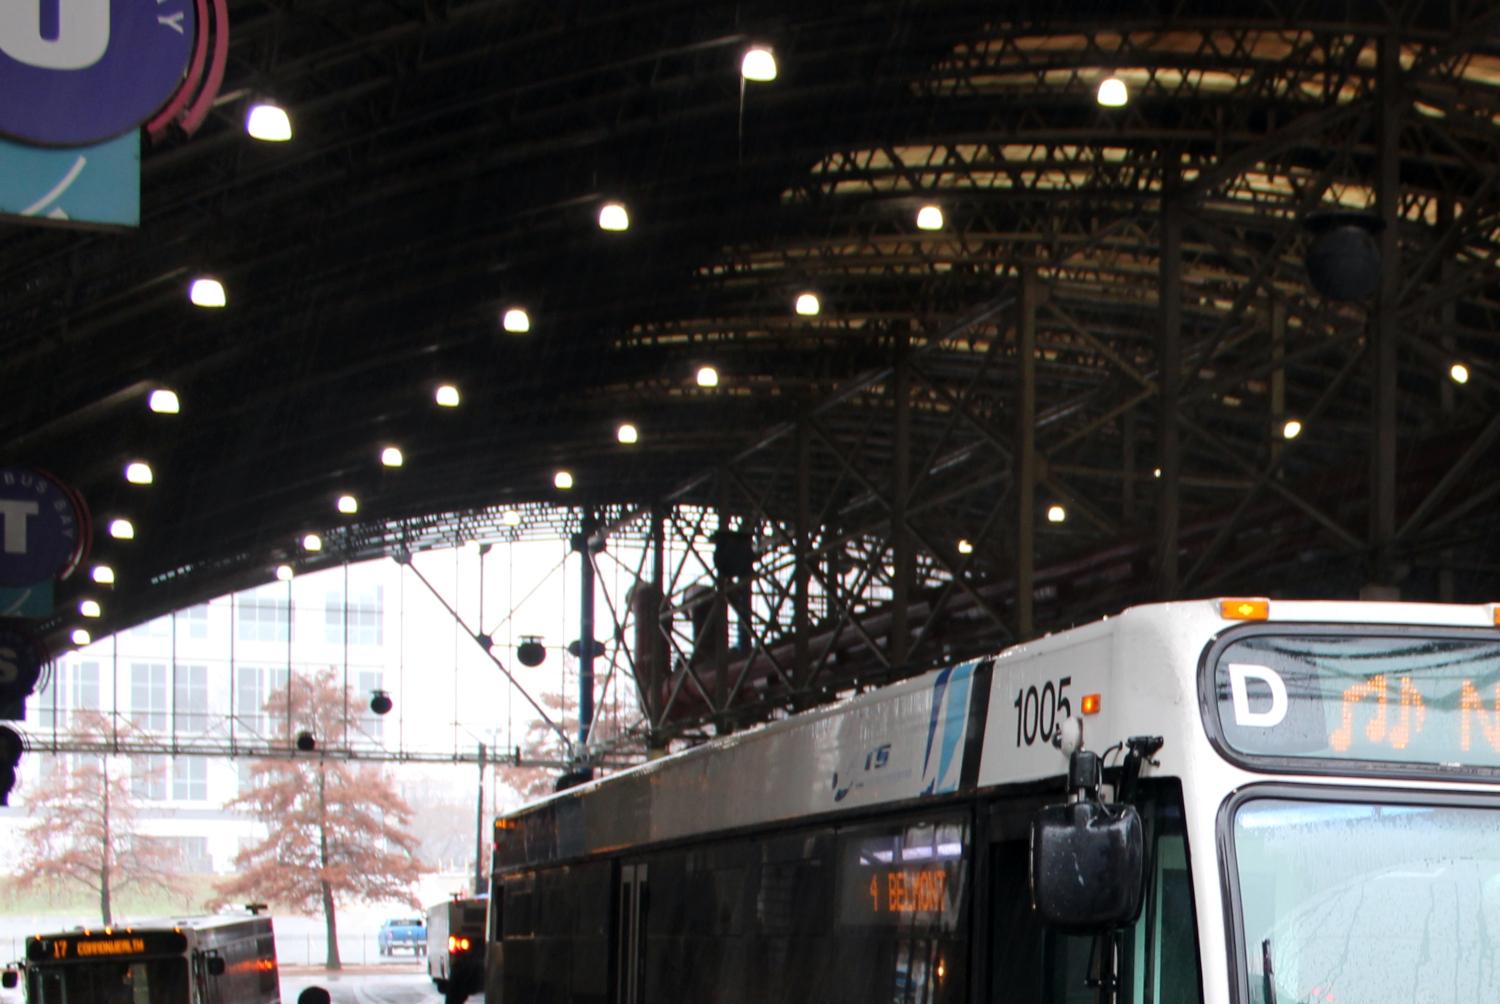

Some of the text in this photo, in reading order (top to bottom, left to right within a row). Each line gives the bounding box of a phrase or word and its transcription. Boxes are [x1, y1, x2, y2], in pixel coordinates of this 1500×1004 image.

[0, 500, 39, 554] T
[1014, 676, 1071, 748] 1005
[1228, 663, 1289, 728] D
[887, 869, 946, 912] BELMONT
